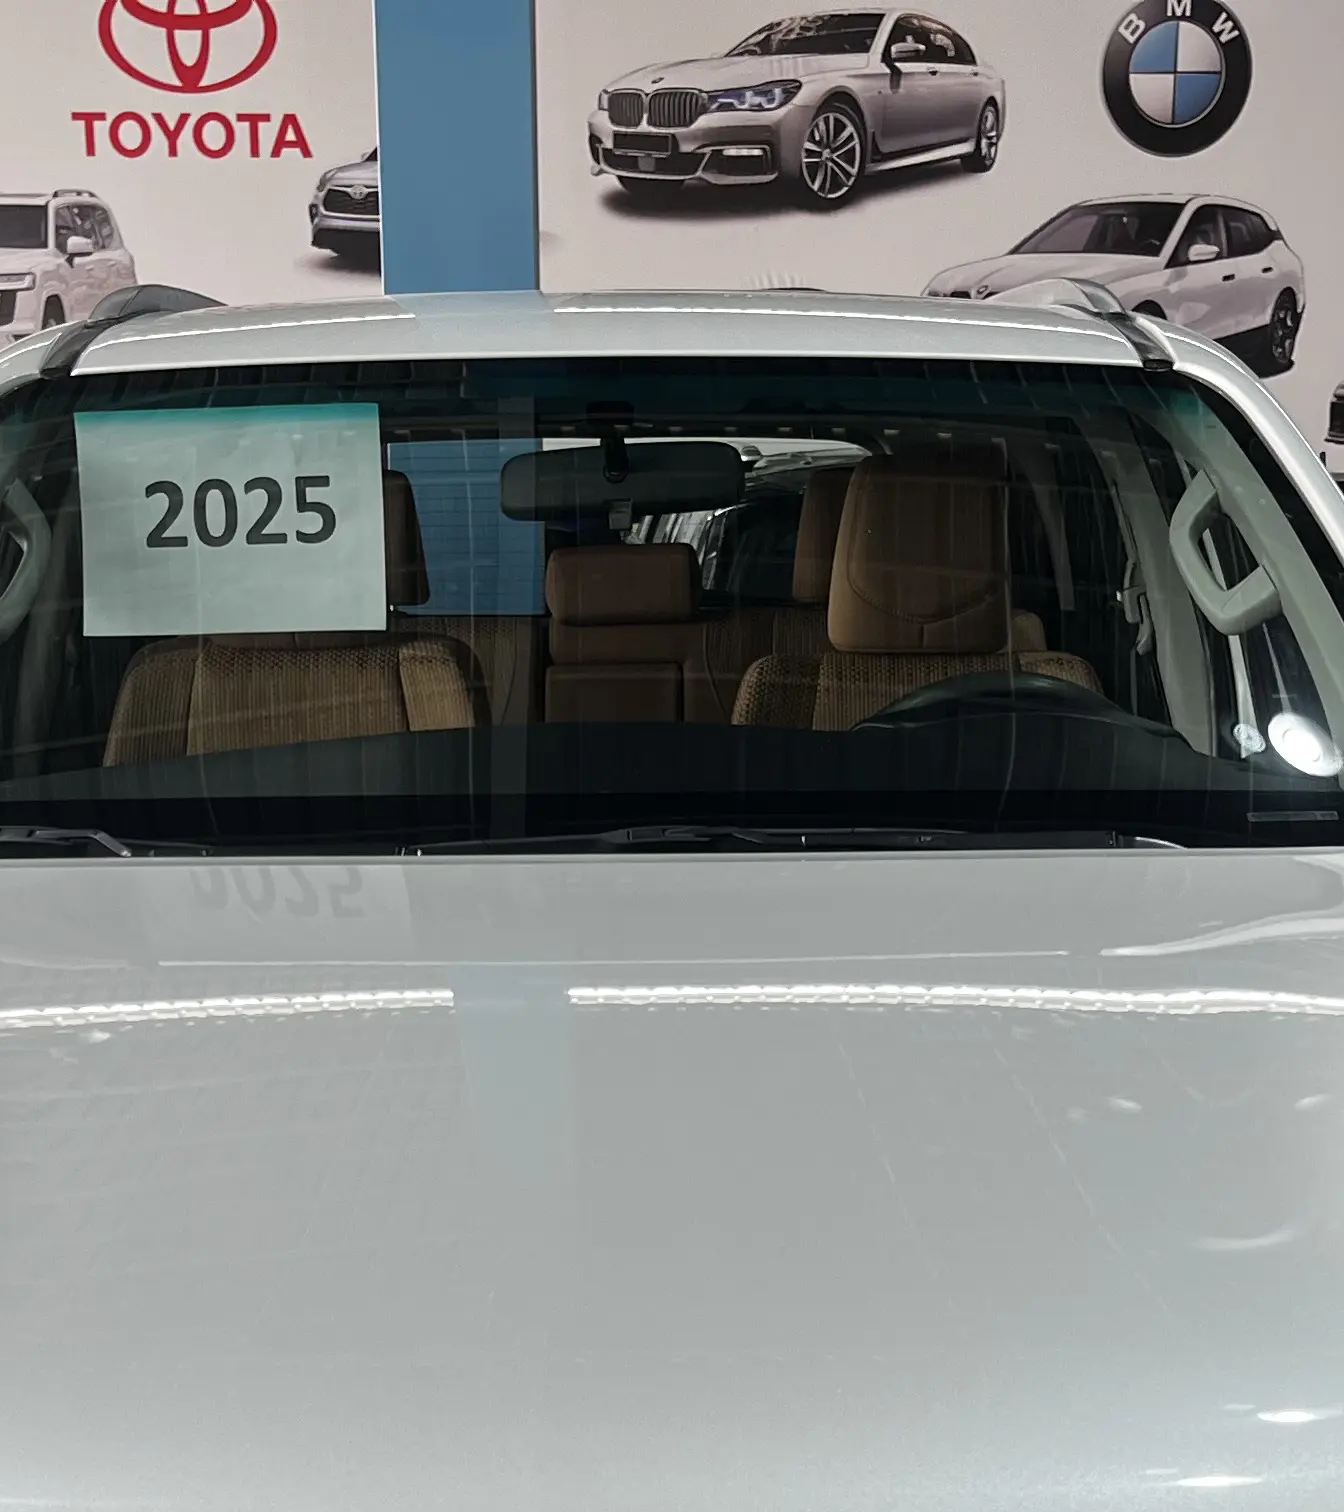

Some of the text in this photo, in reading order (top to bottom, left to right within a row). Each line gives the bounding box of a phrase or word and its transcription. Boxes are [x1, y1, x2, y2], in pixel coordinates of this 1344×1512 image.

[1118, 0, 1240, 45] BMW
[71, 111, 313, 159] TOYOTA
[144, 475, 337, 549] 2025
